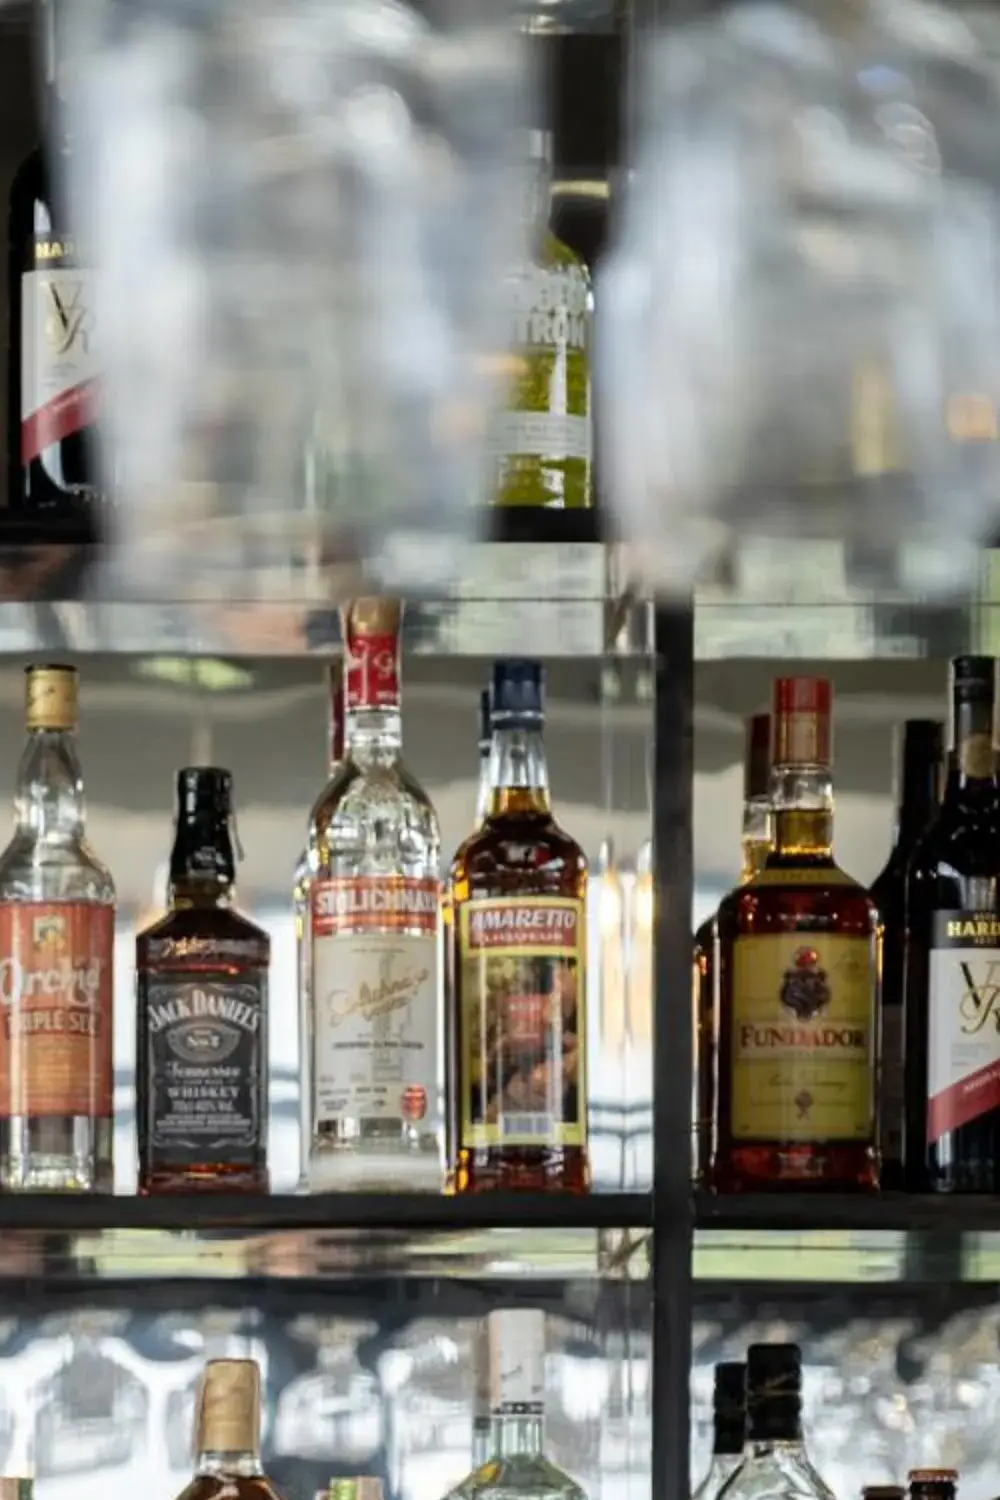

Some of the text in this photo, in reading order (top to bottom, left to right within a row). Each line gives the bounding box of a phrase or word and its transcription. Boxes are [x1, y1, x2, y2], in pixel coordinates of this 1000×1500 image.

[471, 911, 576, 931] AMARETTO
[148, 998, 191, 1033] JACK
[740, 1025, 867, 1048] FUNDADOR
